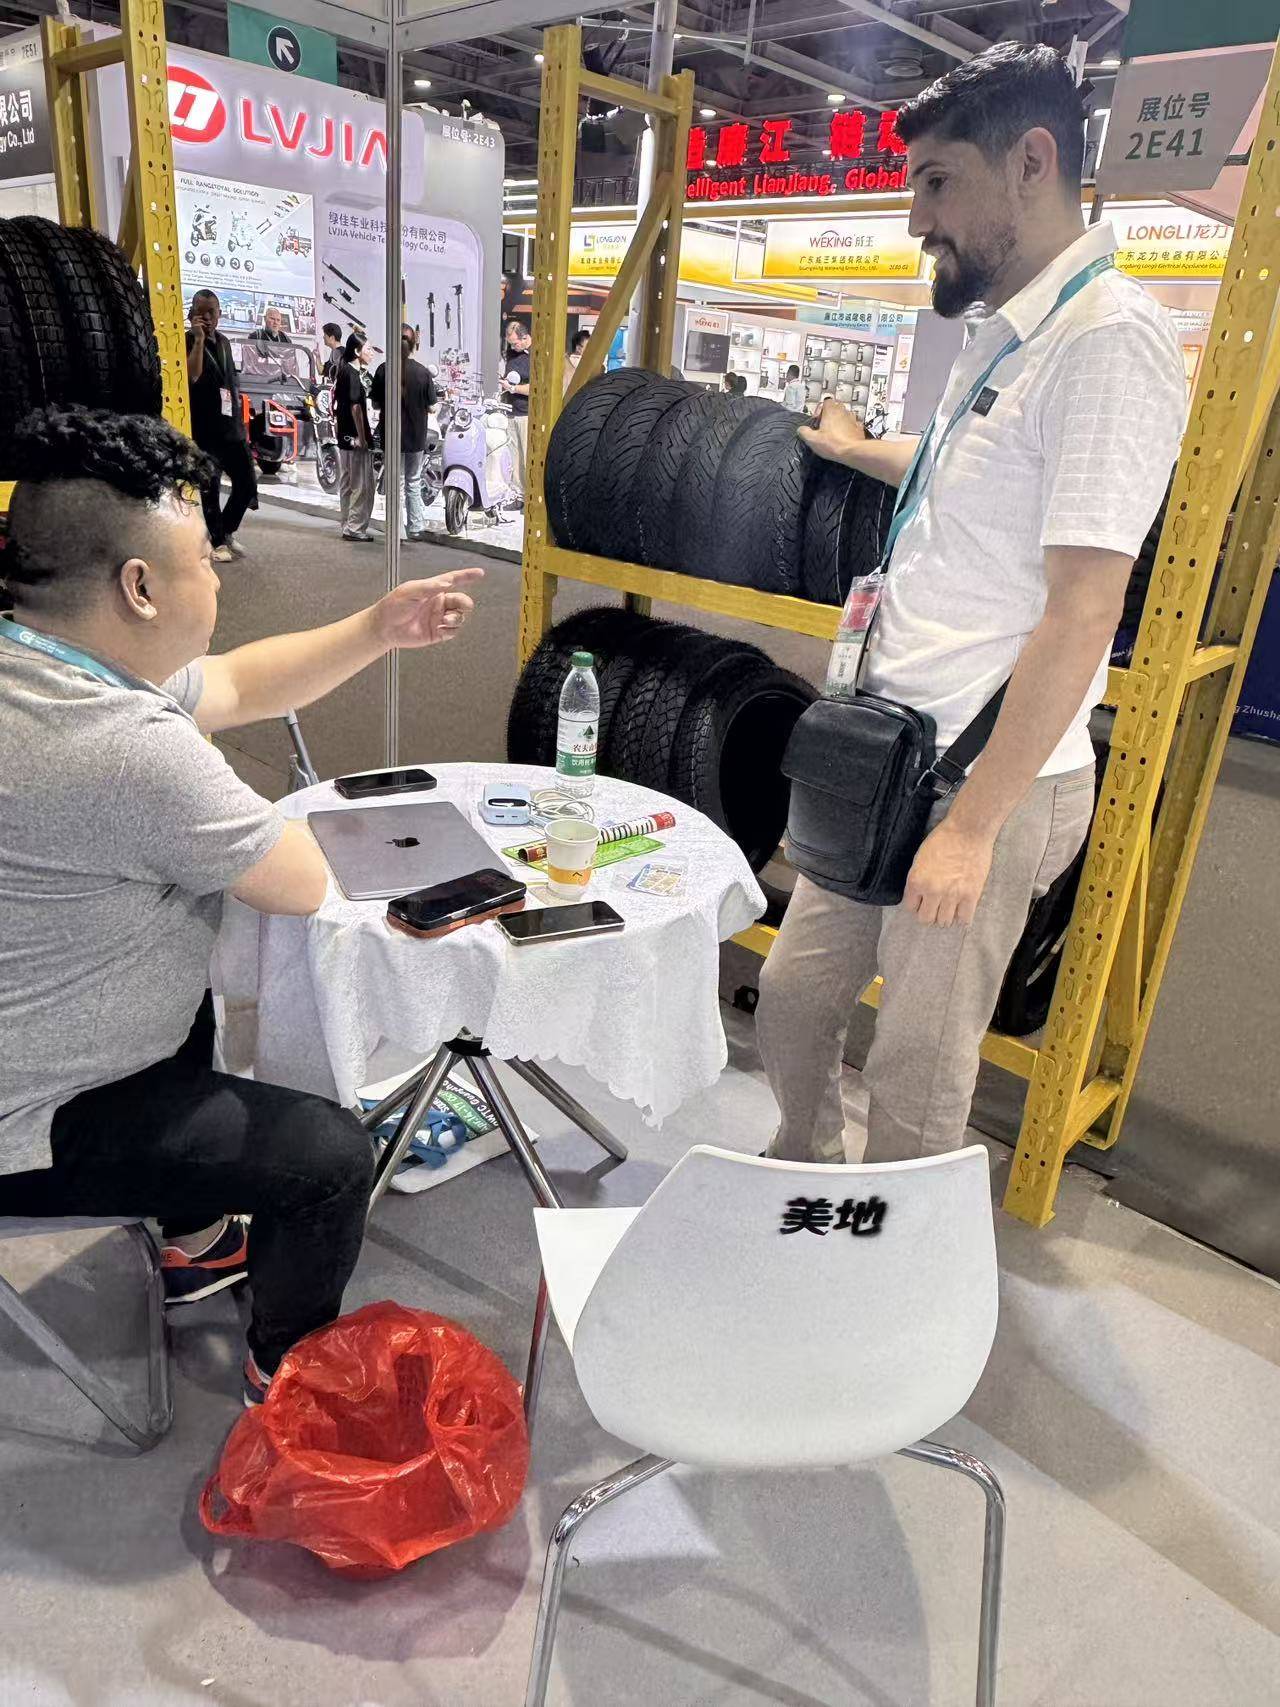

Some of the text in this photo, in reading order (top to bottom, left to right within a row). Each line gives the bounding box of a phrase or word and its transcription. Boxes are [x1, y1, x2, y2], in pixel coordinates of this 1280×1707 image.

[1137, 91, 1211, 123] 展位号
[1125, 128, 1203, 160] 2E41
[845, 166, 908, 190] Global
[328, 226, 348, 237] LVJIA
[350, 230, 377, 242] Vehicle
[809, 236, 852, 248] WEKING
[1127, 225, 1193, 240] LONGLI
[779, 1196, 888, 1237] 美地
